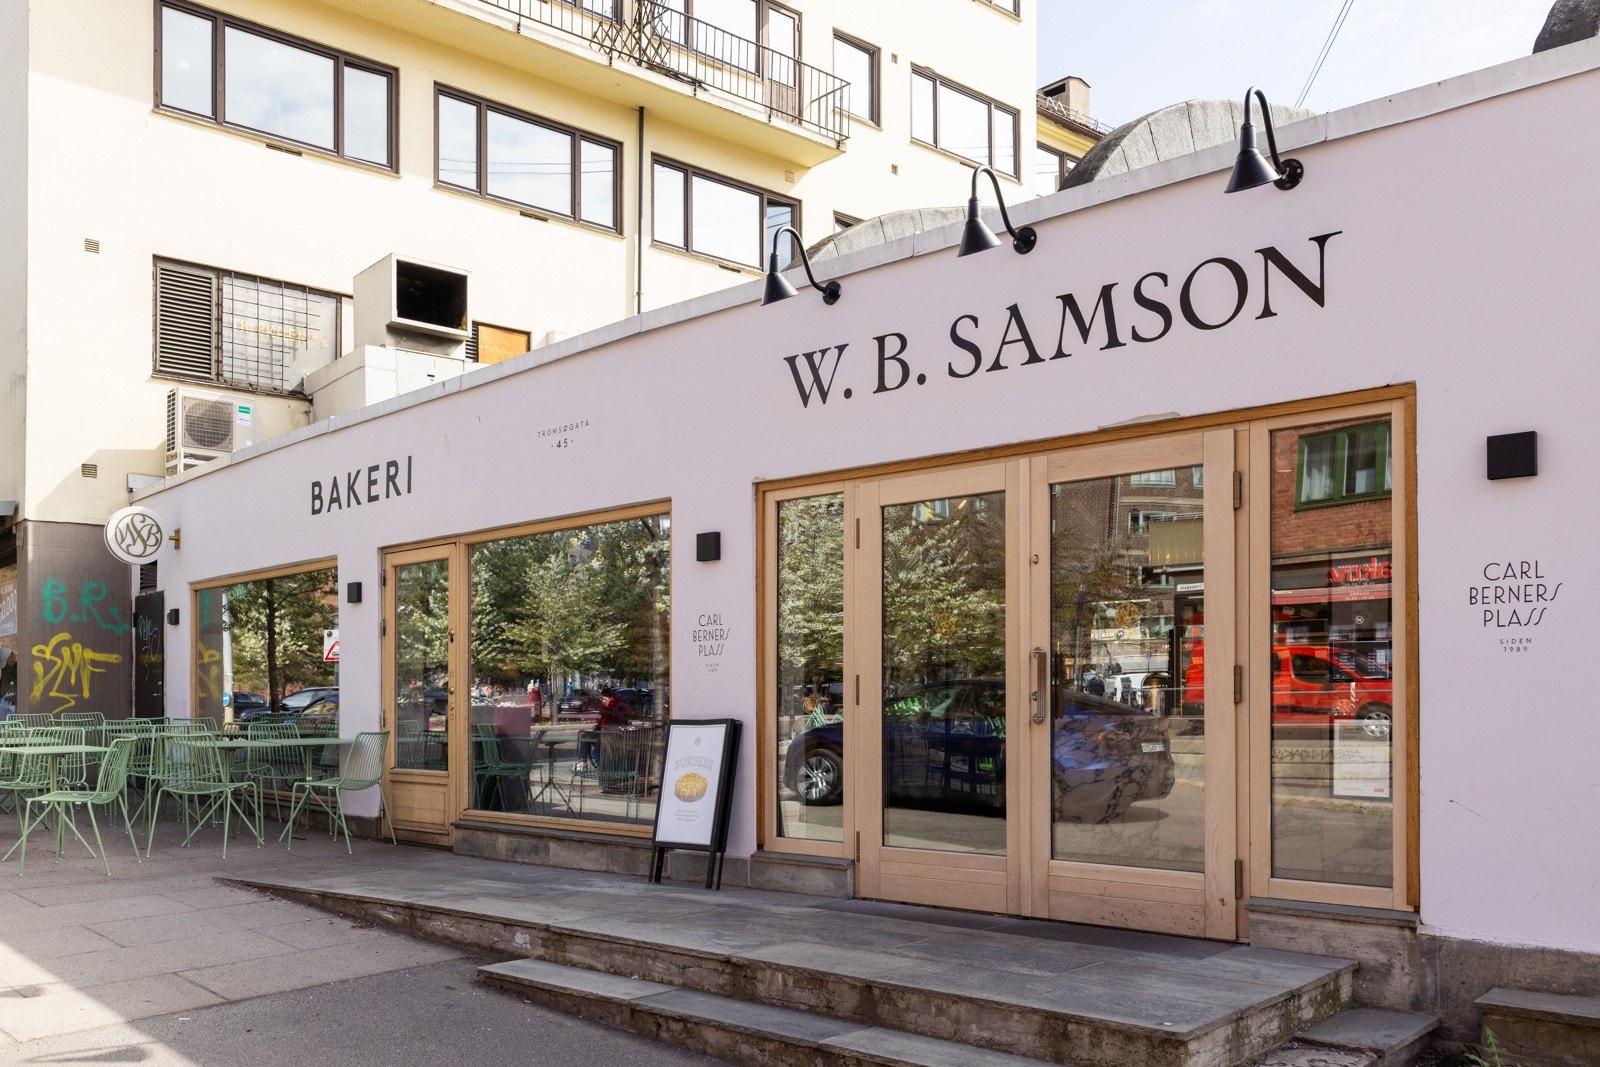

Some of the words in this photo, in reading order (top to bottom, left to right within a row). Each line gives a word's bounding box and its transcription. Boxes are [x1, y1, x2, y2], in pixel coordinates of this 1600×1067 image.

[783, 342, 853, 409] W.
[872, 331, 927, 395] B.
[946, 230, 1343, 379] SAMSON
[537, 419, 590, 438] TROMSØGATA
[311, 455, 414, 516] BAKERI
[1483, 560, 1545, 581] CARL
[1469, 582, 1563, 605] BERNERS
[698, 613, 723, 627] CARL
[1483, 607, 1547, 628] PLASS
[692, 627, 731, 643] BERNERS
[1499, 637, 1532, 645] SIDEN
[698, 643, 725, 657] PLASS
